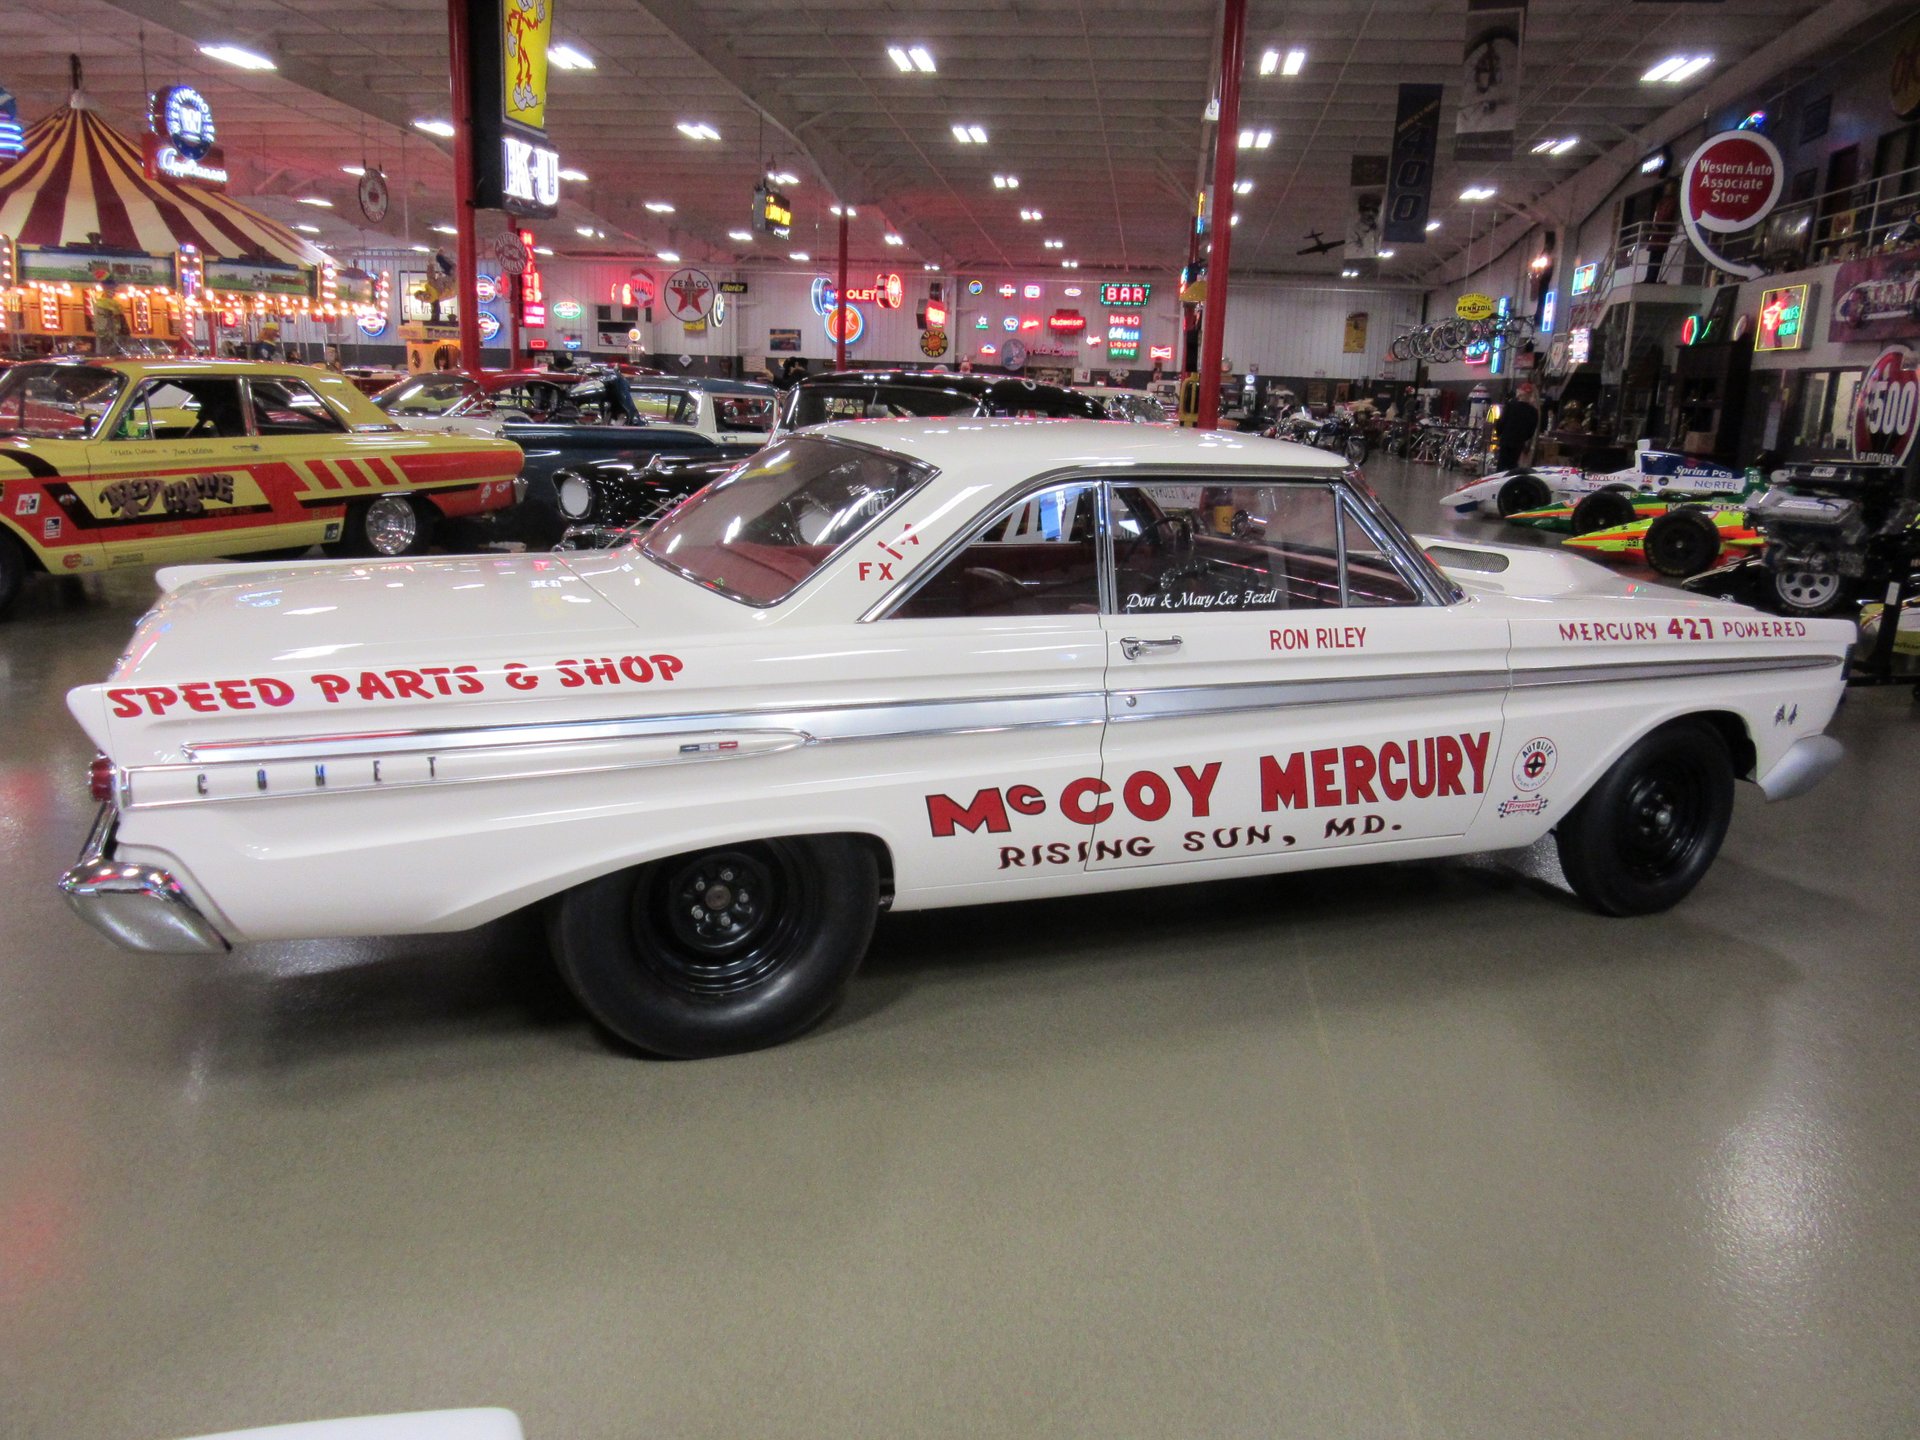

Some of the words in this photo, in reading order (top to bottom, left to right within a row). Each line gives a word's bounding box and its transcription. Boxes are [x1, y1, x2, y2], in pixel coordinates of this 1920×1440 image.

[170, 87, 215, 142] WESTINGHOUSE
[158, 147, 227, 182] Appliances
[1700, 159, 1744, 175] Western
[1746, 161, 1774, 176] Auto
[1701, 175, 1764, 189] Associate
[1711, 189, 1750, 204] Store
[672, 279, 710, 289] TEXACO
[1106, 287, 1143, 301] BAR
[402, 304, 456, 316] CHEVRLET
[1458, 304, 1491, 313] PENNZOIL
[1050, 316, 1084, 326] Budweiser
[1109, 315, 1140, 326] BAR-B-Q
[923, 345, 945, 357] CARS
[1110, 349, 1137, 357] WINE
[1674, 465, 1709, 477] Sprint
[1711, 469, 1733, 480] PCS
[1694, 480, 1739, 491] NORTEL
[1126, 593, 1156, 608] Don
[1160, 593, 1173, 609] &
[1174, 590, 1214, 608] Mary
[1215, 591, 1239, 606] Lee
[1558, 622, 1657, 641] MERCURY
[1667, 618, 1714, 641] 427
[1722, 621, 1807, 638] POWERED
[1269, 628, 1310, 651] RON
[1315, 627, 1367, 649] RILEY
[107, 677, 295, 719] SPEED
[311, 665, 485, 704] PARTS
[505, 663, 540, 691] &
[557, 654, 685, 697] SHOP
[1522, 741, 1555, 759] AUTOLITE
[197, 756, 436, 795] COMET
[1258, 731, 1490, 813] MERCURY
[1508, 802, 1539, 810] Firestone
[998, 836, 1156, 869] RISING
[1183, 825, 1297, 852] SUN,
[1323, 813, 1403, 849] MD.
